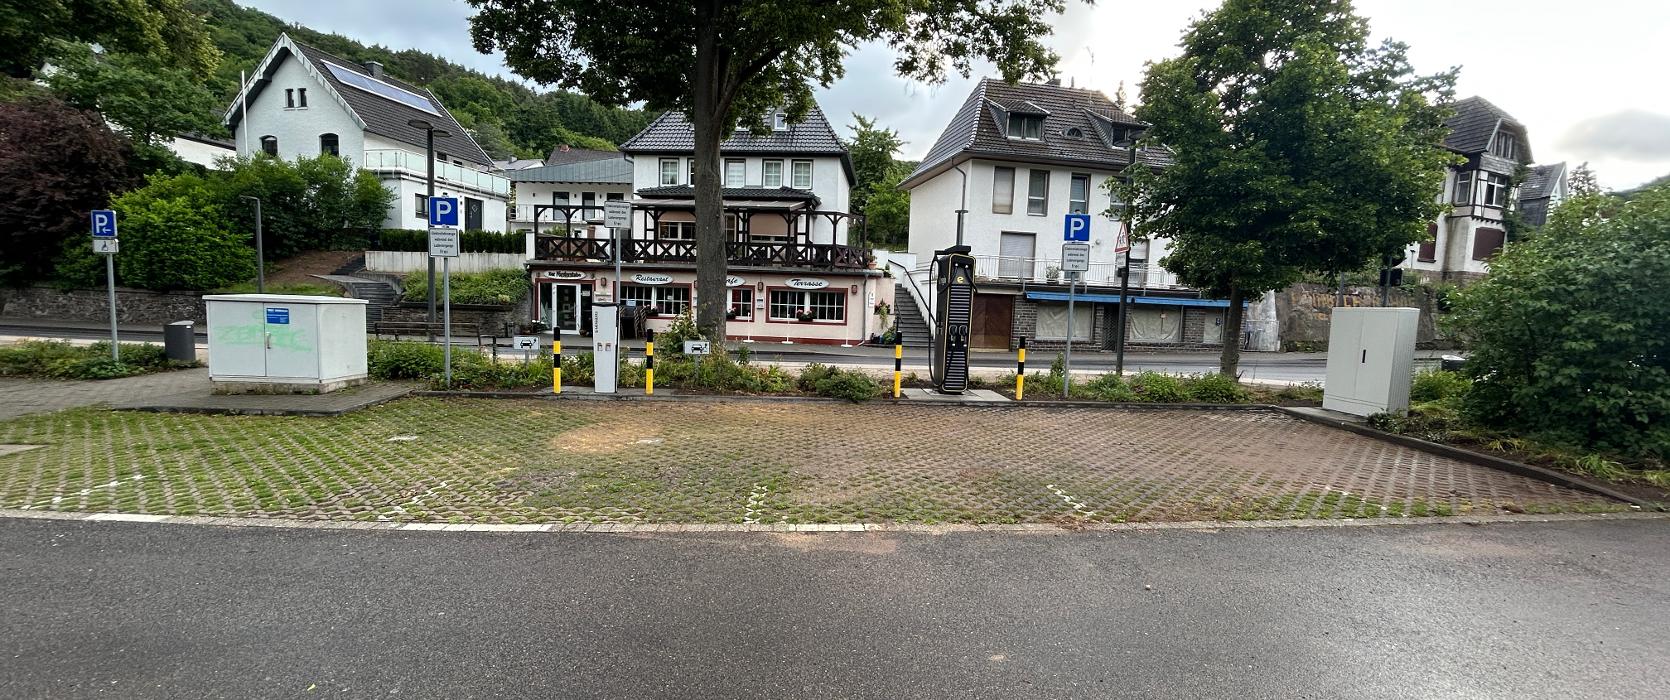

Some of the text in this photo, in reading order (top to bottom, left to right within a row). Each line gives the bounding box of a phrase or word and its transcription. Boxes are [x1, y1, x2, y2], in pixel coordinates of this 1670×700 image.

[436, 200, 452, 222] P
[95, 214, 108, 234] P
[1070, 217, 1085, 239] P
[636, 274, 669, 282] Restaurant
[726, 277, 738, 285] afe
[791, 279, 823, 287] Terrasse
